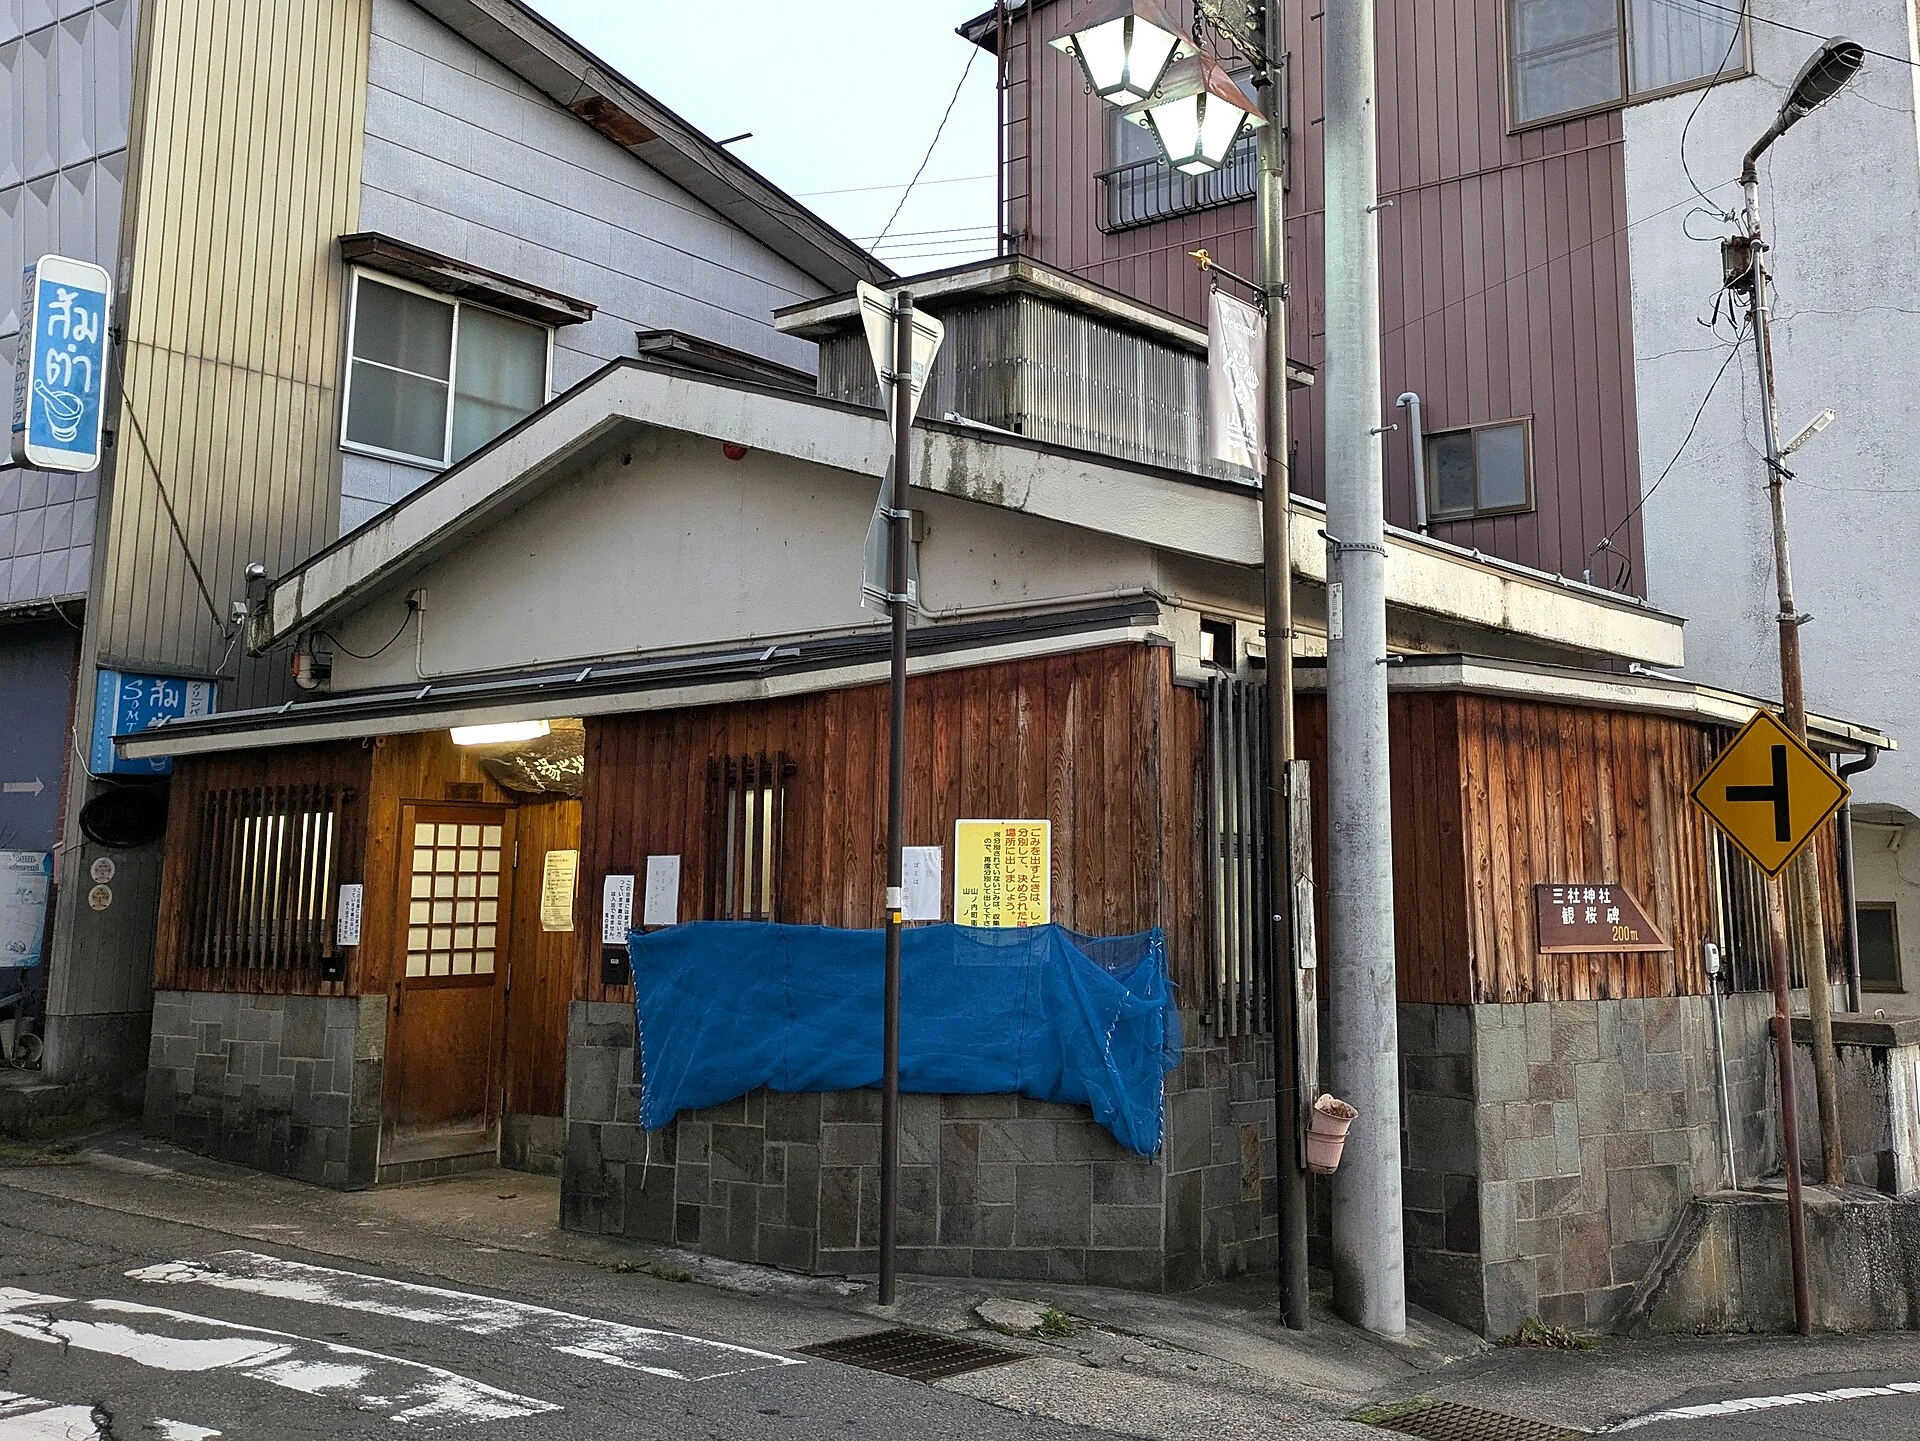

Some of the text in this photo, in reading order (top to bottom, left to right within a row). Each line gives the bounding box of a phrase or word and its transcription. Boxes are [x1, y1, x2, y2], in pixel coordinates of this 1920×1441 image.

[48, 287, 98, 344] ส้ม
[1221, 316, 1258, 340] Welcome!
[149, 679, 179, 708] ส้ม
[1005, 828, 1016, 915] 場所に出しましょう。
[1552, 887, 1612, 905] 三社神社
[1612, 925, 1639, 942] 200m
